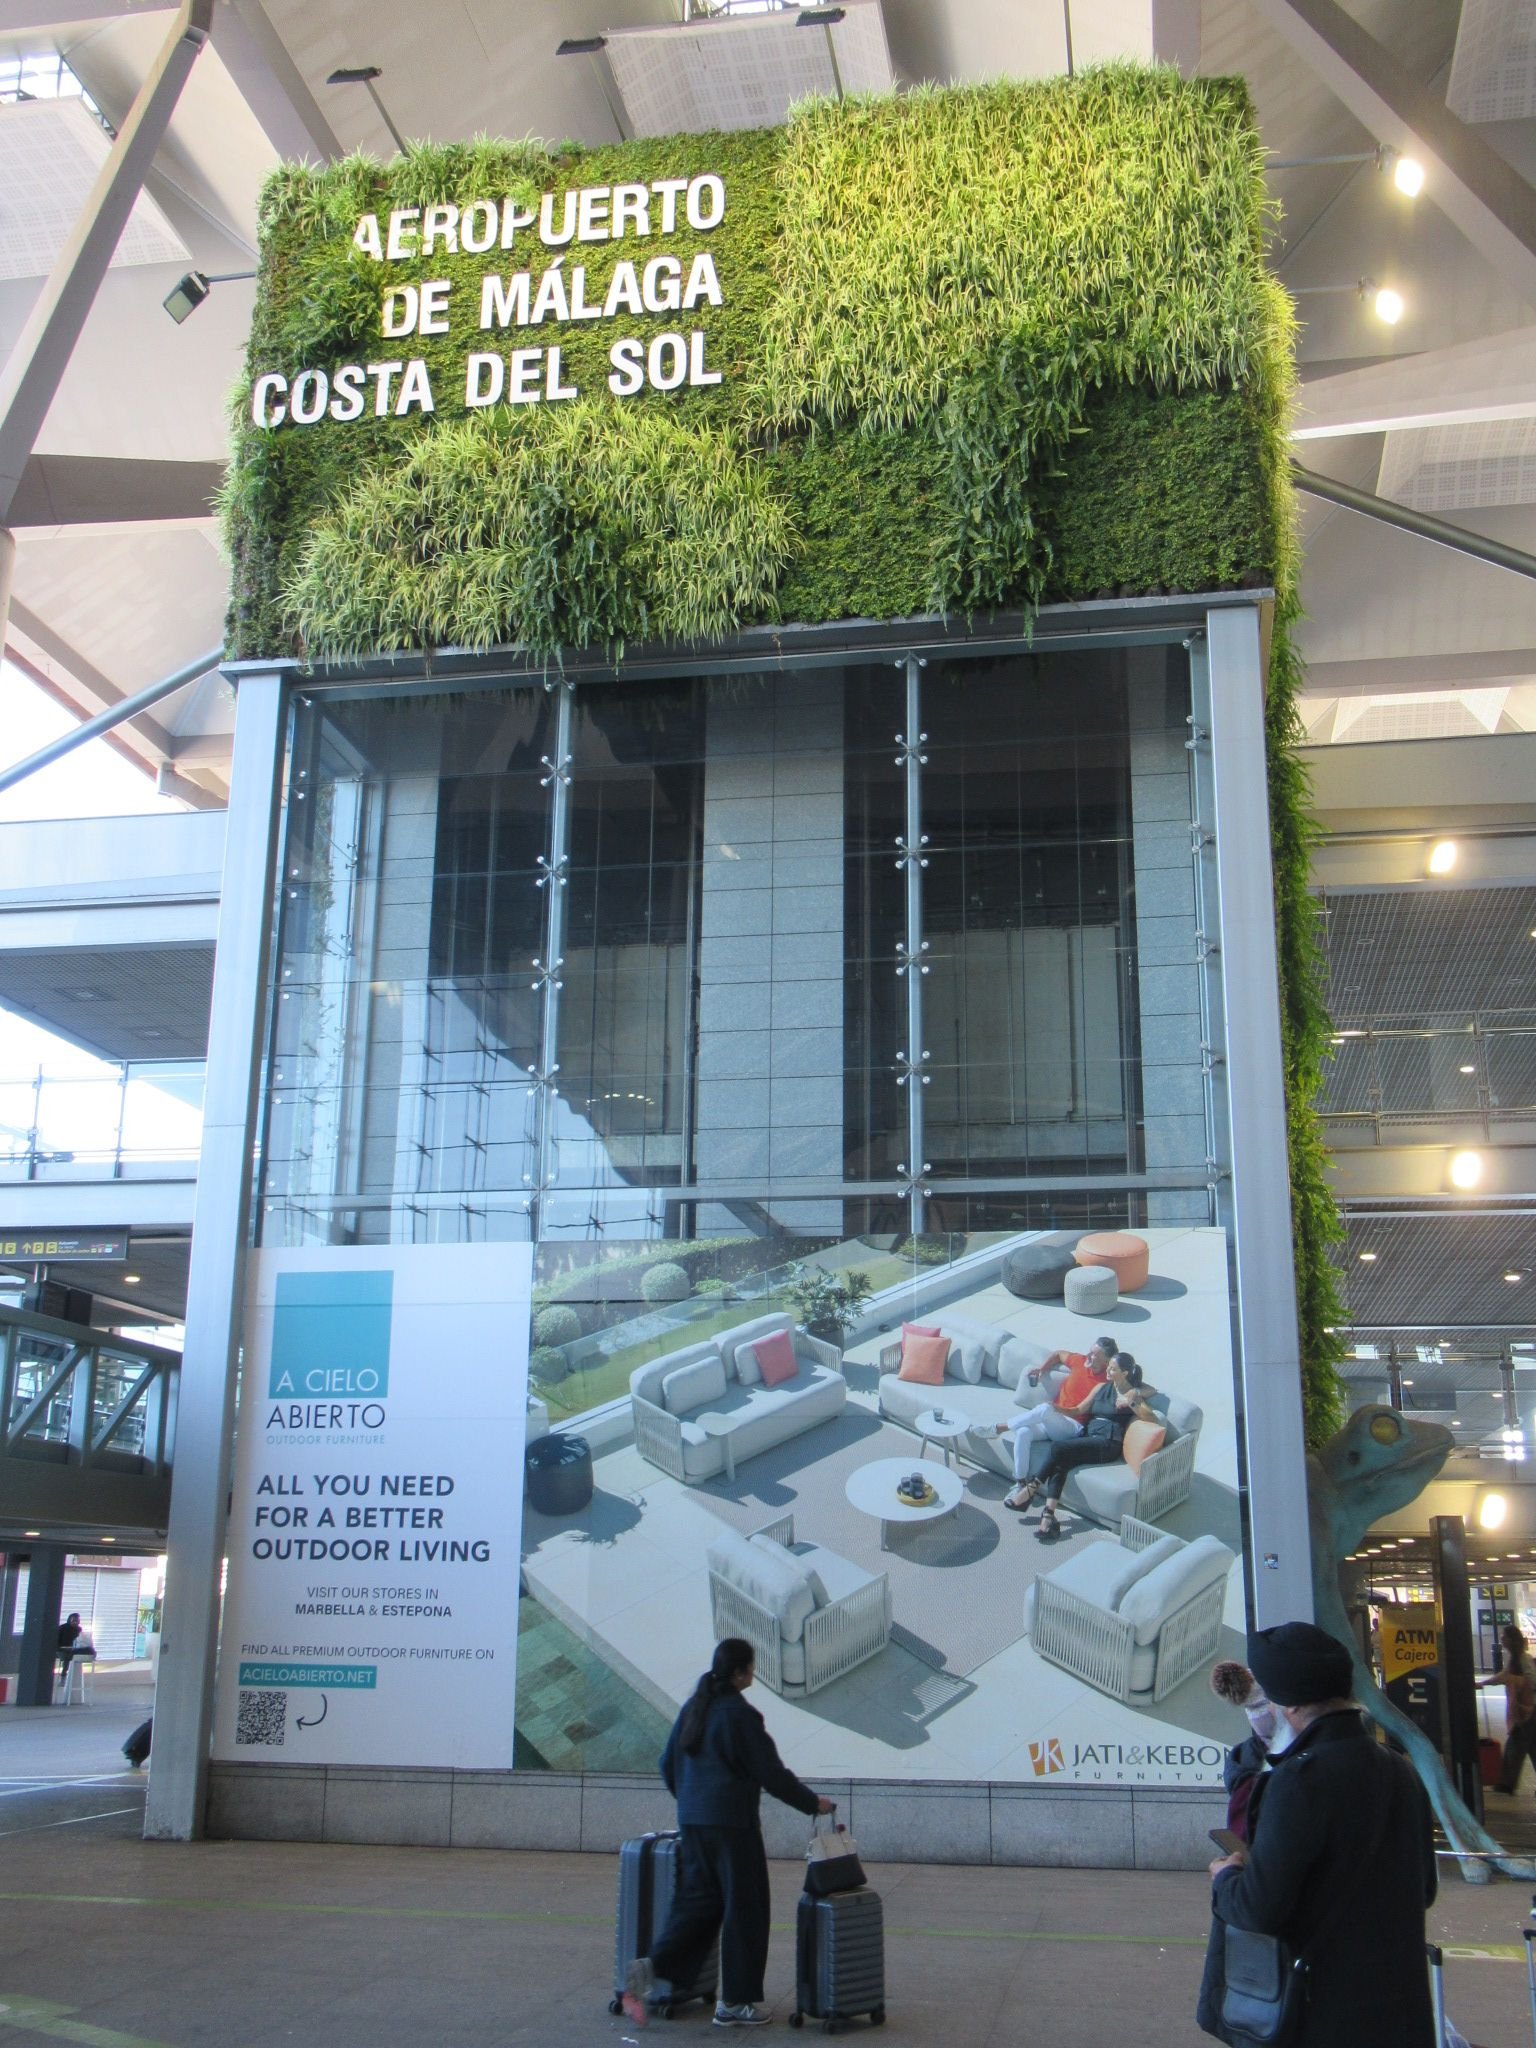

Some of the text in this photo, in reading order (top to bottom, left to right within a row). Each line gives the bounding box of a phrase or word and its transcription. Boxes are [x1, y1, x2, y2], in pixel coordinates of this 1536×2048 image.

[348, 173, 725, 262] AEROPUERTO
[381, 253, 724, 339] DE MÁLAGA
[251, 331, 723, 429] COSTA DEL SOL
[275, 1367, 379, 1393] A CIELO
[266, 1403, 386, 1430] ABIERTO
[265, 1434, 385, 1446] OUTDOOR FURNITURE
[257, 1474, 455, 1497] ALL YOU NEED
[255, 1506, 444, 1529] FOR A BETTER
[252, 1537, 491, 1563] OUTDOOR LIVING
[306, 1587, 439, 1600] VISIT OUR STORES IN
[295, 1604, 452, 1617] MARBELLA & ESTEPONA
[1394, 1629, 1435, 1645] ATM
[241, 1644, 495, 1660] FIND ALL PREMIUM OUTDOOR FURNITURE ON
[1394, 1647, 1436, 1663] Cajero
[242, 1667, 374, 1684] ACIELOABIERTO.NET
[1074, 1771, 1225, 1782] FURNITUR
